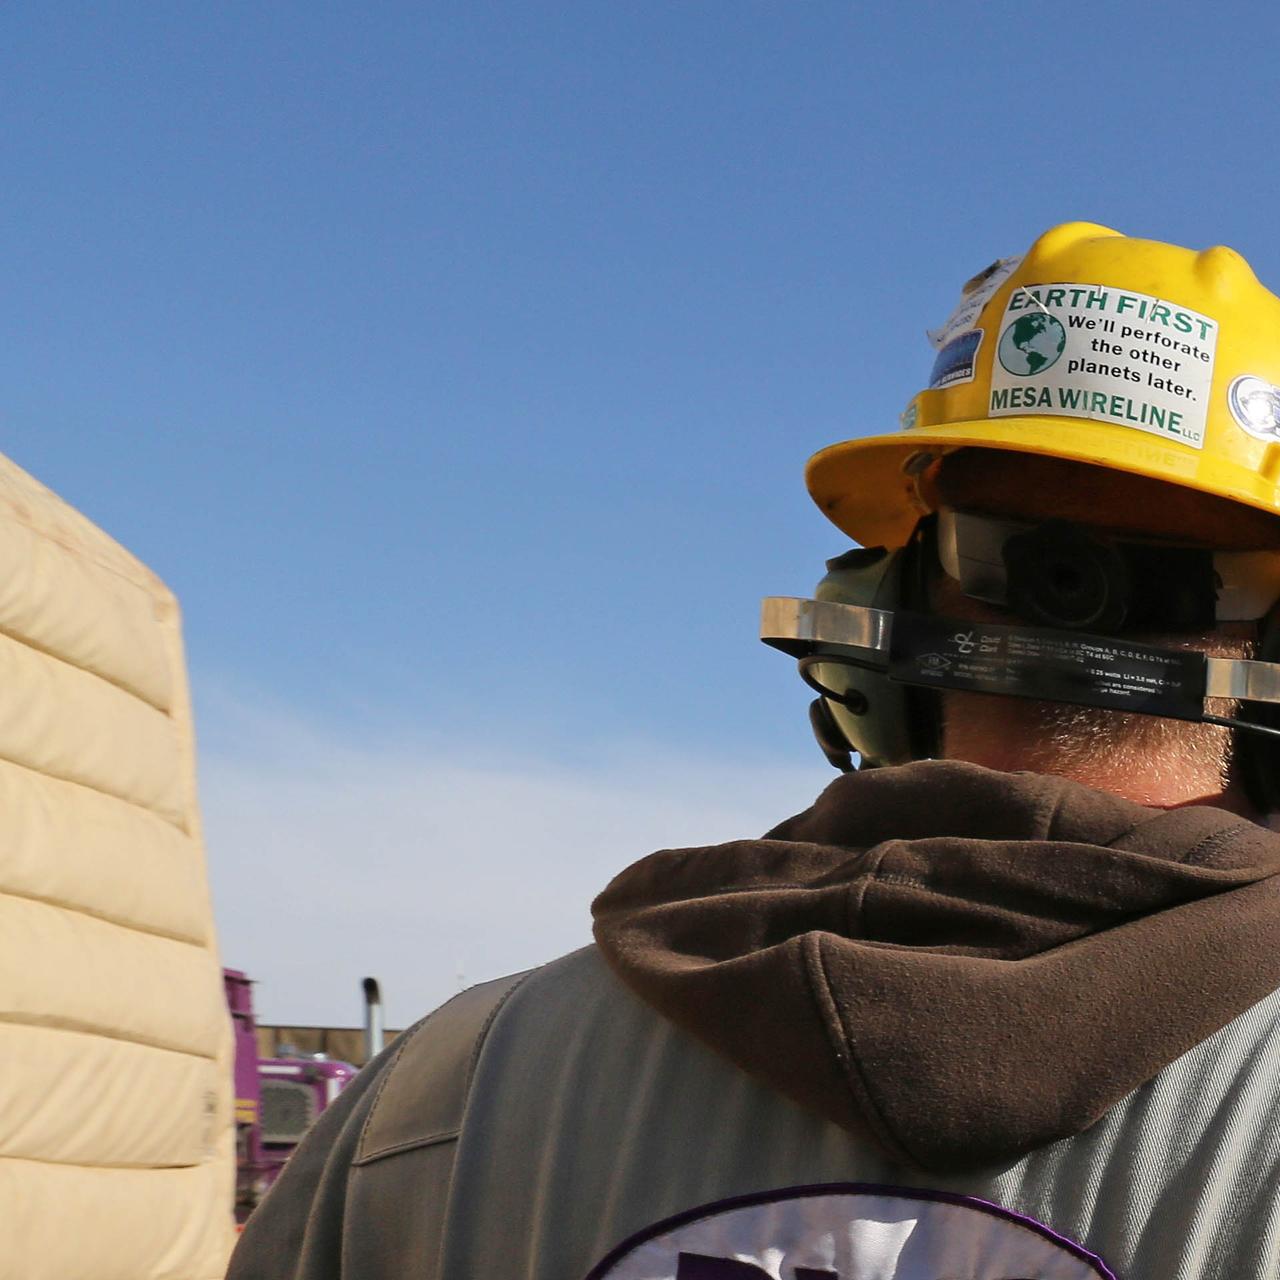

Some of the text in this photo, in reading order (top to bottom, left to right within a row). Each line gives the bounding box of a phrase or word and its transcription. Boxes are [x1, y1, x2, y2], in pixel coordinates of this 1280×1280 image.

[1008, 289, 1109, 311] EARTH
[1116, 294, 1214, 342] FIRST
[1068, 315, 1210, 363] We'll perforate
[1091, 338, 1181, 372] the other
[1068, 358, 1197, 401] planets later.
[991, 386, 1200, 441] MESA WIRELINE LLC
